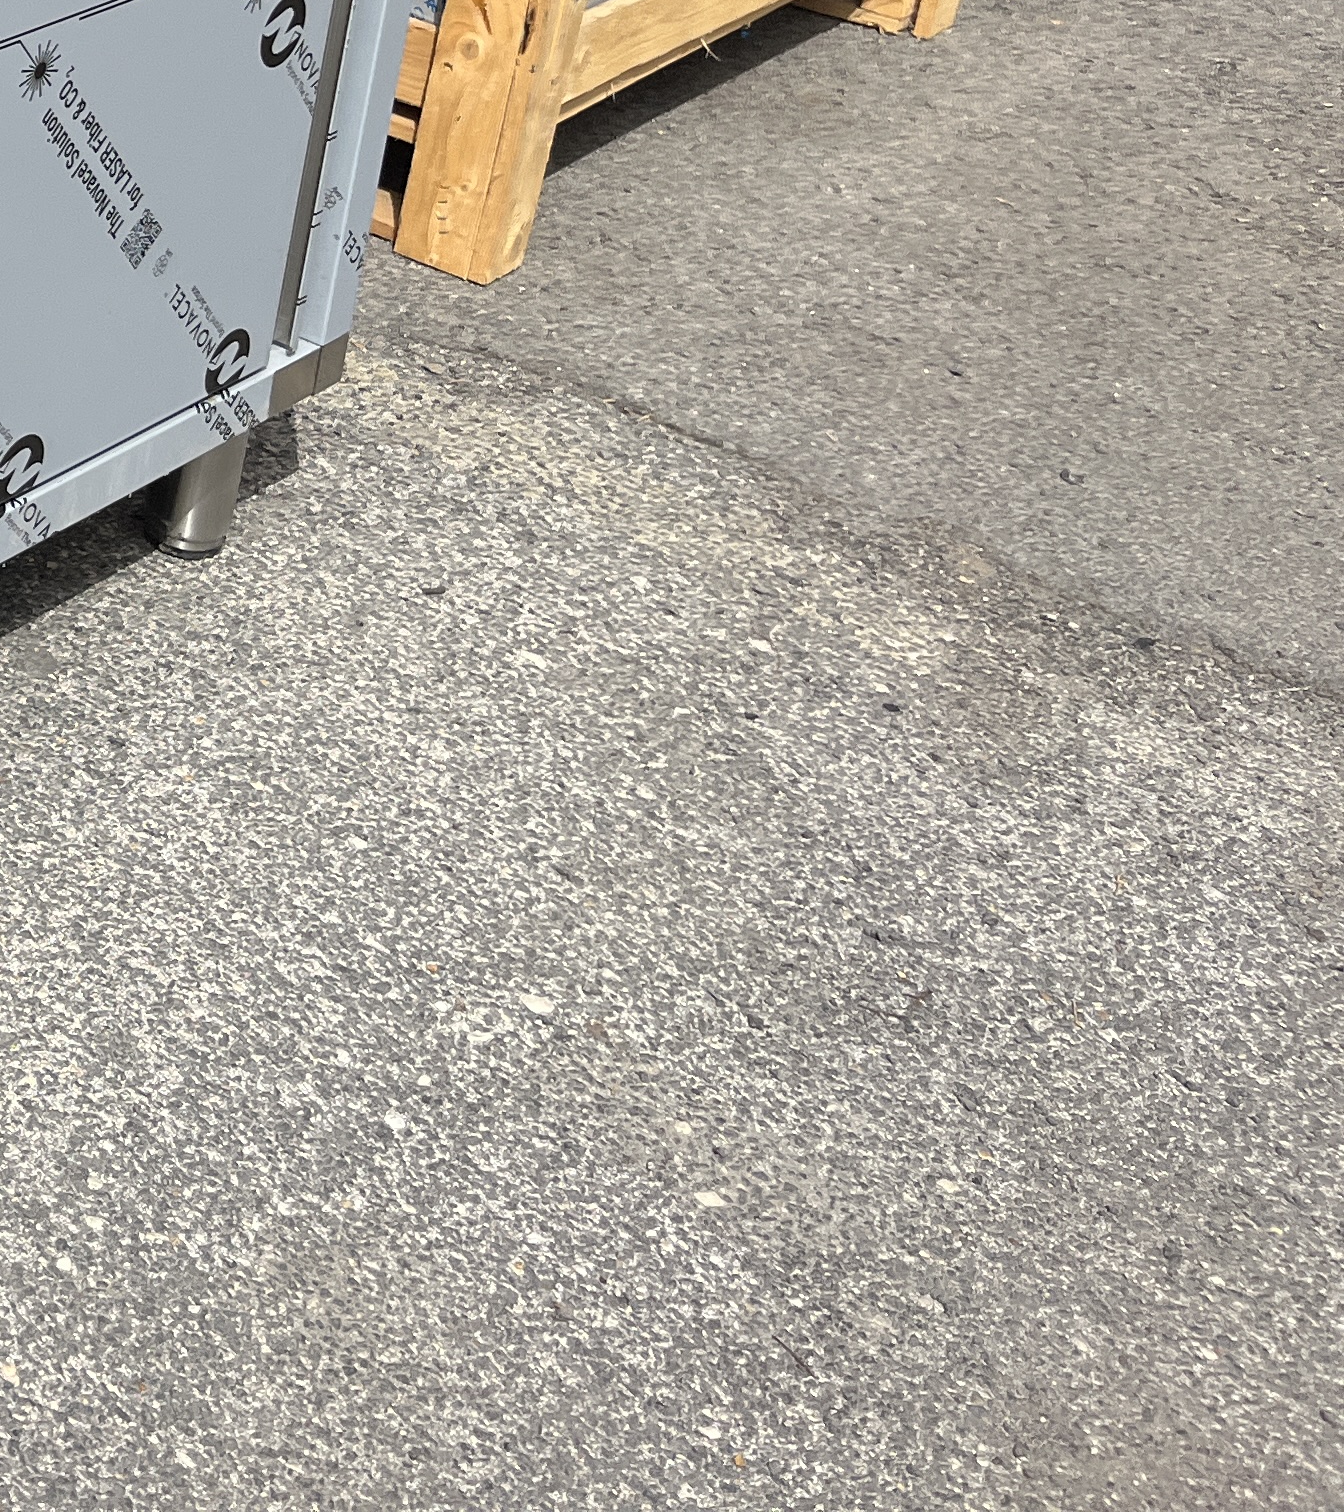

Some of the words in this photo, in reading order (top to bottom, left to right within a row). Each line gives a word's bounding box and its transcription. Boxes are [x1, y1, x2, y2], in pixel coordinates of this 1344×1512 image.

[72, 98, 87, 121] &
[81, 111, 110, 155] Fiber
[41, 107, 80, 170] Solution
[70, 159, 113, 218] Novacel
[100, 143, 134, 193] LASER
[128, 184, 145, 212] for
[107, 210, 125, 240] The
[167, 282, 217, 363] NOVACEL
